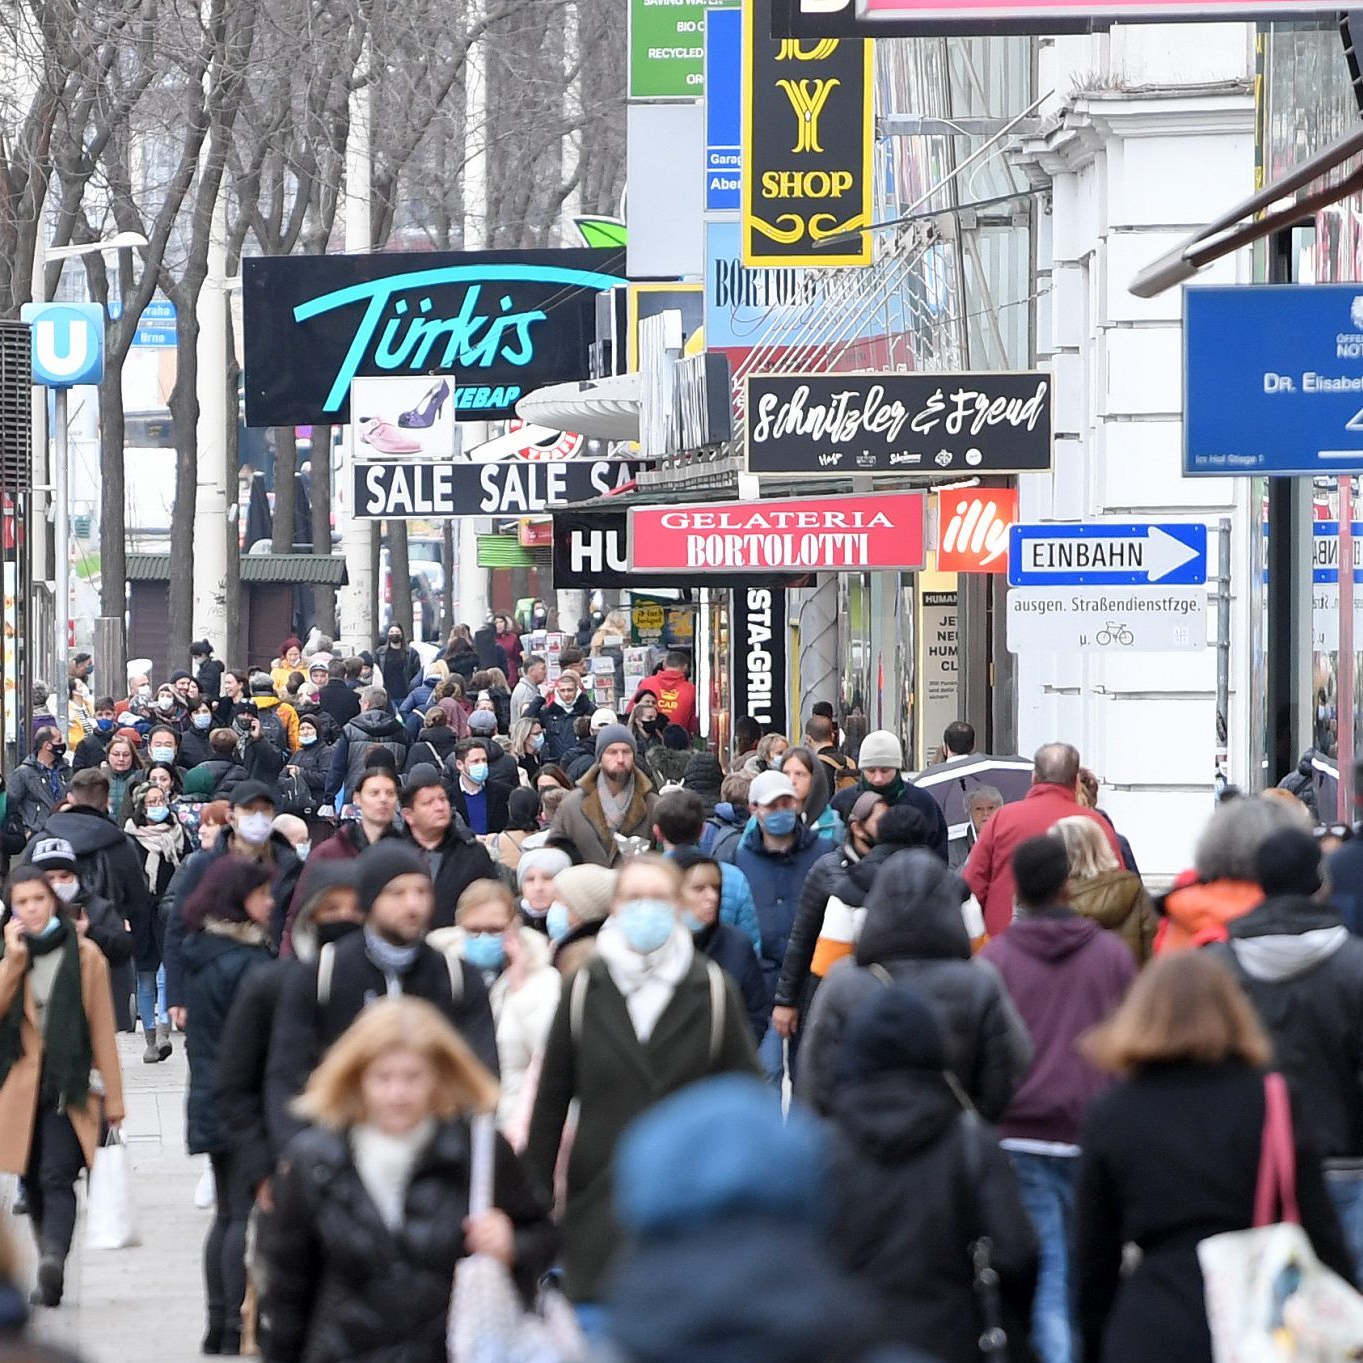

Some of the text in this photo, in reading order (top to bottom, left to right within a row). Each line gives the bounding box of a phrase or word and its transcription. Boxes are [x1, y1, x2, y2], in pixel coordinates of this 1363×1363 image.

[677, 21, 696, 32] BIO
[648, 47, 704, 59] RECYCLED
[761, 171, 853, 199] SHOP
[37, 320, 87, 375] U
[293, 264, 629, 412] Türkis
[753, 384, 910, 443] Schnitzler
[945, 381, 1048, 435] Freud
[366, 461, 647, 514] SALE SALE SA
[660, 512, 895, 530] GELATERIA
[943, 499, 1013, 566] illy
[686, 533, 869, 567] BORTOLOTTI
[1032, 543, 1144, 568] EINBAHN
[1014, 597, 1201, 614] ausgen. Straßendienstfzge.
